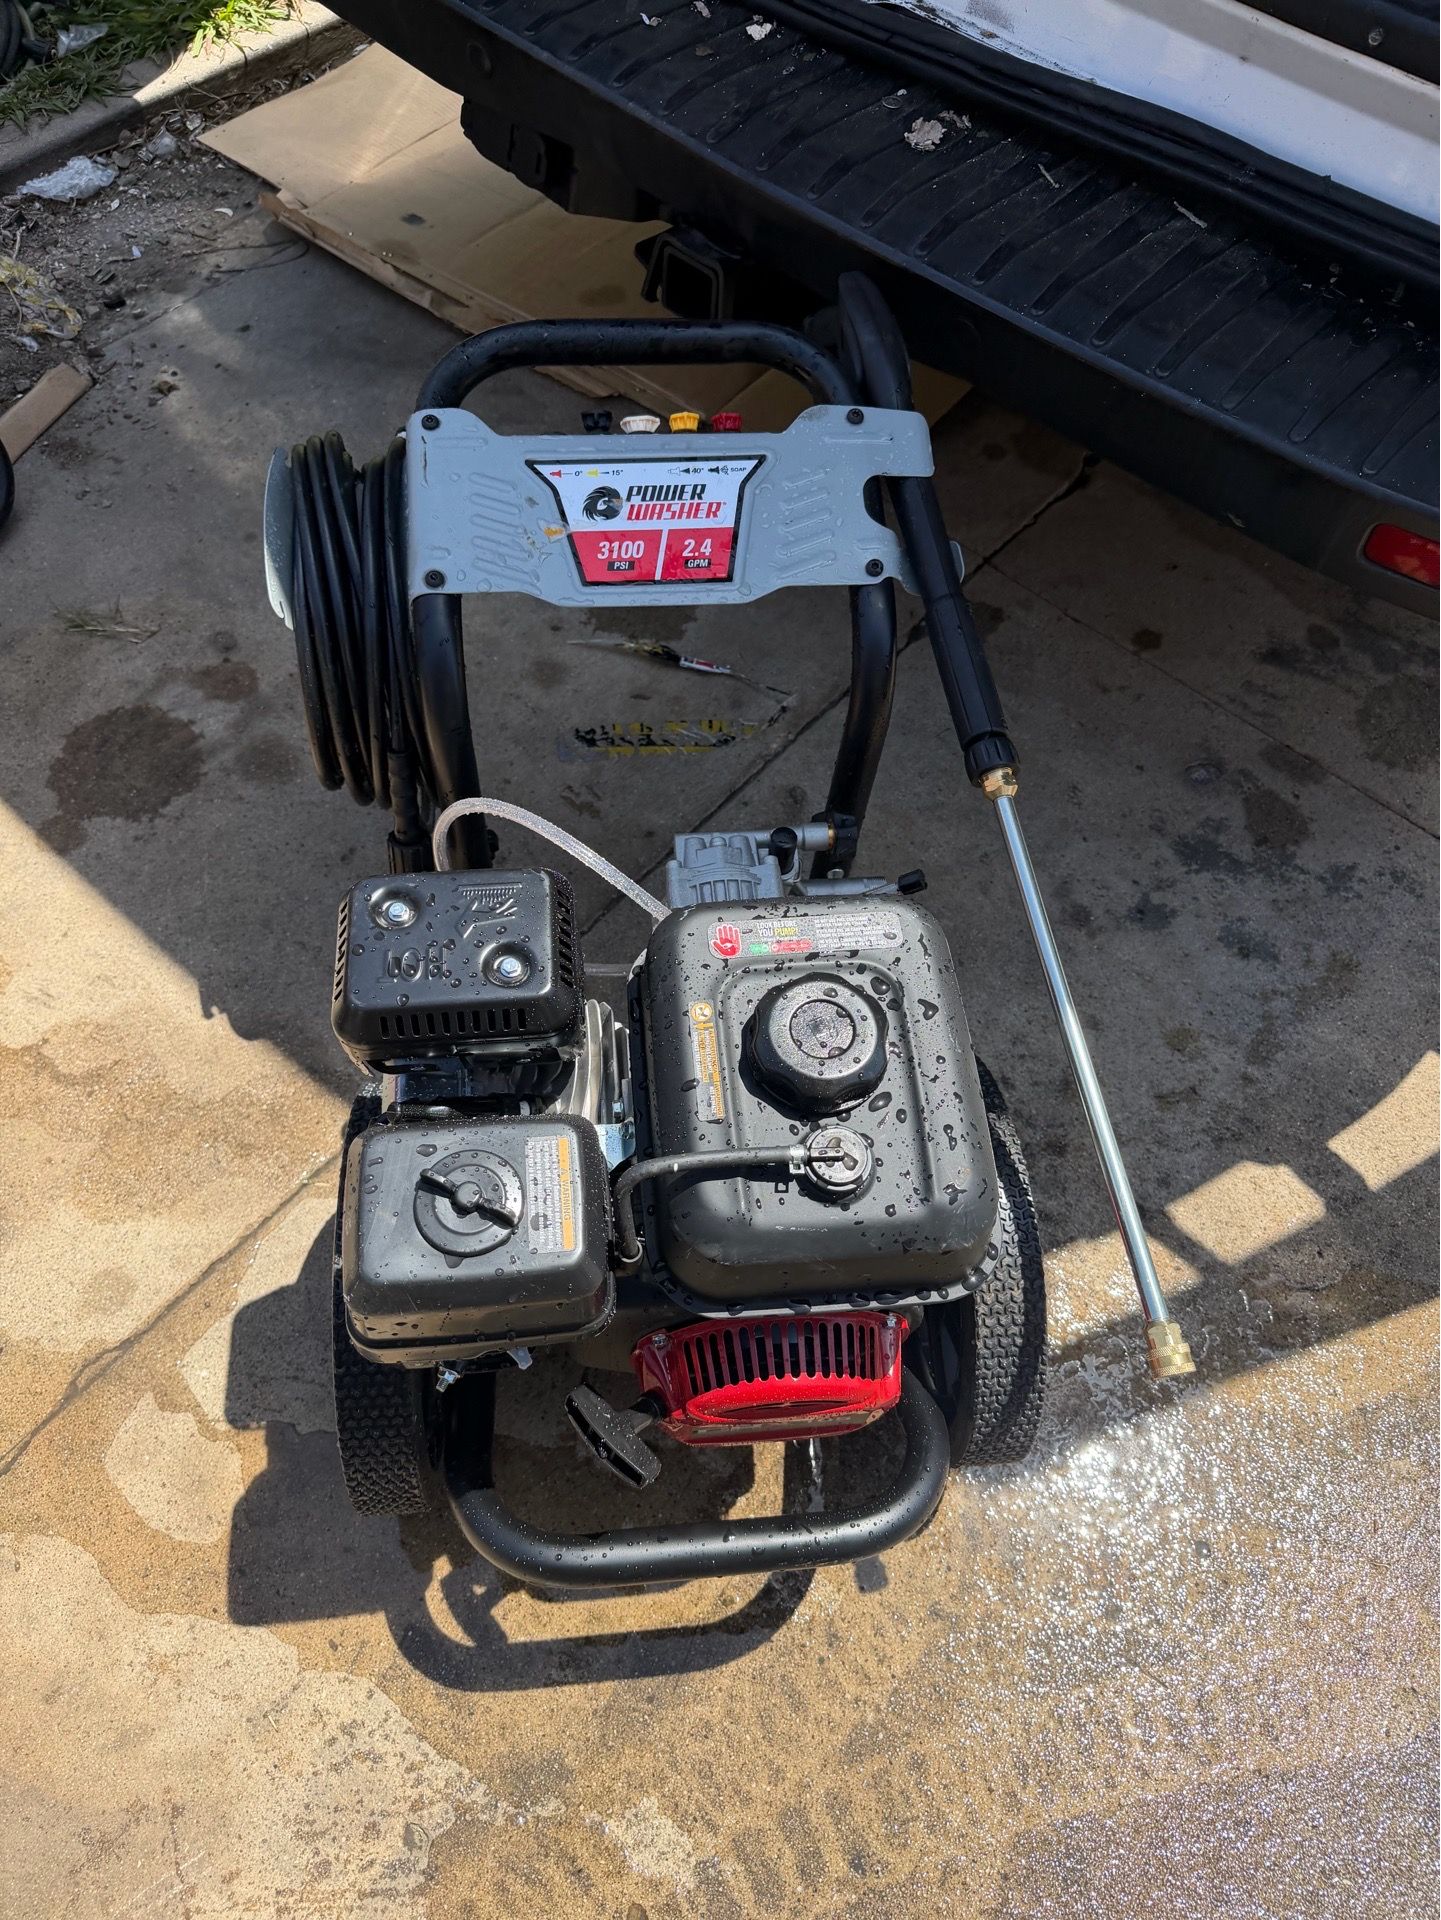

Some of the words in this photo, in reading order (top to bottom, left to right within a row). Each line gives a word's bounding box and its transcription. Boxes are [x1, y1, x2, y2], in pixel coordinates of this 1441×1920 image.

[625, 483, 707, 502] POWER
[597, 540, 645, 559] 3100
[682, 538, 712, 557] 2.4
[613, 561, 629, 570] PSI
[687, 559, 708, 568] GPM
[756, 922, 773, 930] LOOK
[773, 920, 798, 928] BEFORE
[758, 928, 773, 937] YOU
[561, 1180, 571, 1220] WARNING
